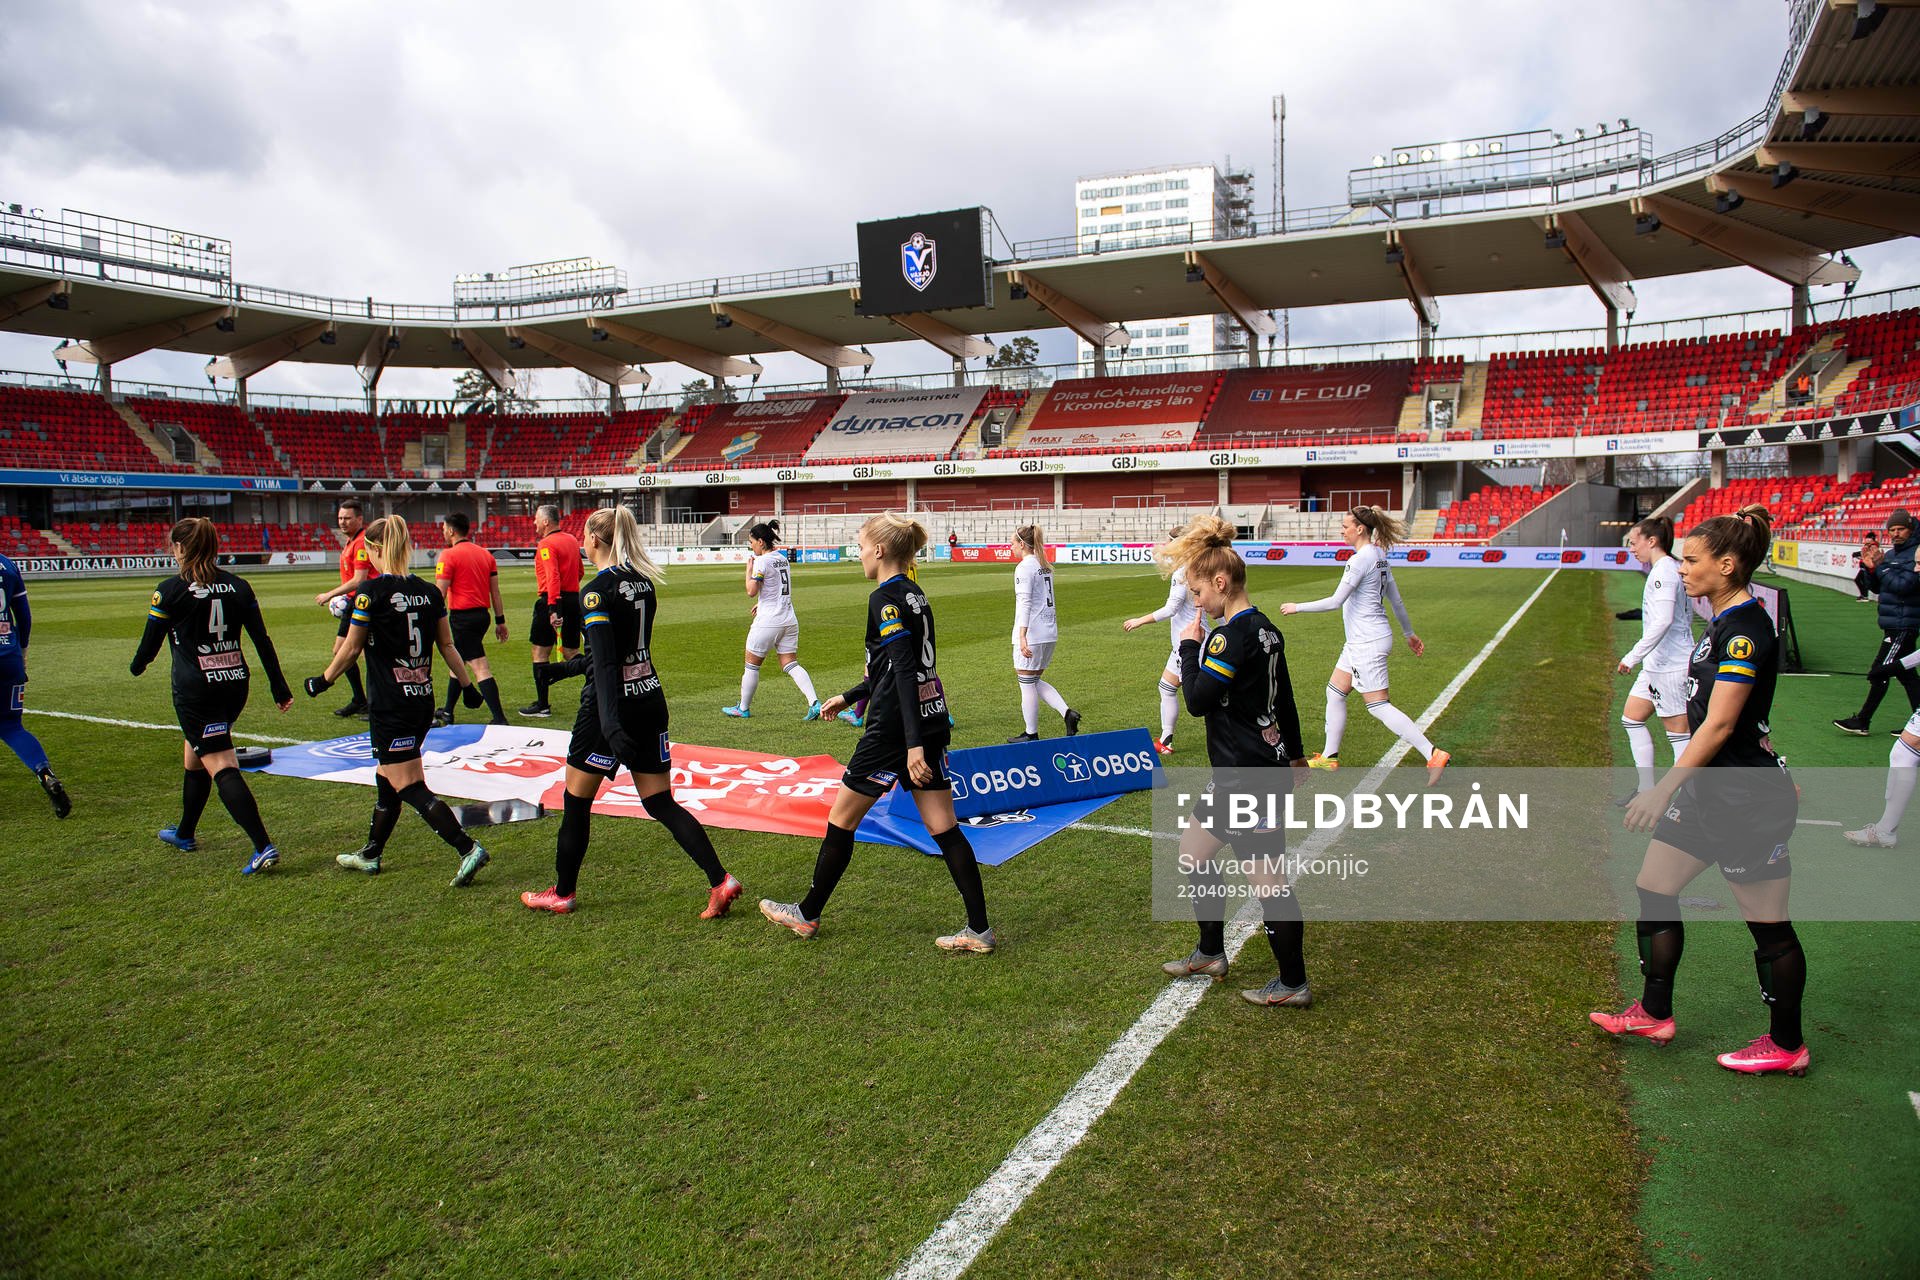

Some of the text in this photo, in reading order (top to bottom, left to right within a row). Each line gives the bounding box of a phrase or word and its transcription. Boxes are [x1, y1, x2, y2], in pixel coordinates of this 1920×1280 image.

[866, 393, 961, 405] ARENAPARTNER
[1052, 384, 1204, 402] Dina ICA-handlare
[1279, 383, 1372, 402] LF CUP
[1063, 398, 1163, 412] Kronobergs
[1166, 395, 1194, 407] län
[831, 412, 964, 435] dynacon
[1020, 460, 1066, 472] GBJ bygg.
[1112, 456, 1160, 469] GBJ bygg.
[1210, 453, 1262, 466] GBJ bygg.
[777, 470, 797, 481] GBJ
[853, 467, 893, 478] GBJ bygg.
[934, 463, 977, 475] GBJ bygg.
[60, 474, 125, 486] Vi älskar Växjö
[705, 473, 725, 484] GBJ
[961, 549, 979, 557] VEAB
[994, 549, 1012, 557] VEAB
[1071, 548, 1152, 562] EMILSHUS
[1266, 550, 1285, 560] GO
[1336, 550, 1355, 560] GO
[1408, 550, 1428, 561] GO
[1483, 551, 1504, 562] GO
[1561, 551, 1582, 562] GO
[31, 559, 61, 572] DEN
[63, 558, 118, 571] LOKALA
[121, 556, 179, 569] IDROTTE
[206, 583, 236, 593] VIDA
[629, 581, 652, 594] VIDA
[779, 568, 790, 596] 9
[1043, 576, 1054, 608] 3
[406, 594, 431, 607] VIDA
[208, 598, 228, 641] 4
[407, 612, 422, 658] 5
[921, 614, 935, 668] 6
[206, 668, 247, 683] FUTURE
[624, 675, 661, 697] FUTURE
[591, 755, 613, 766] ALWEX
[1092, 750, 1155, 778] OBOS
[970, 765, 1043, 795] OBOS
